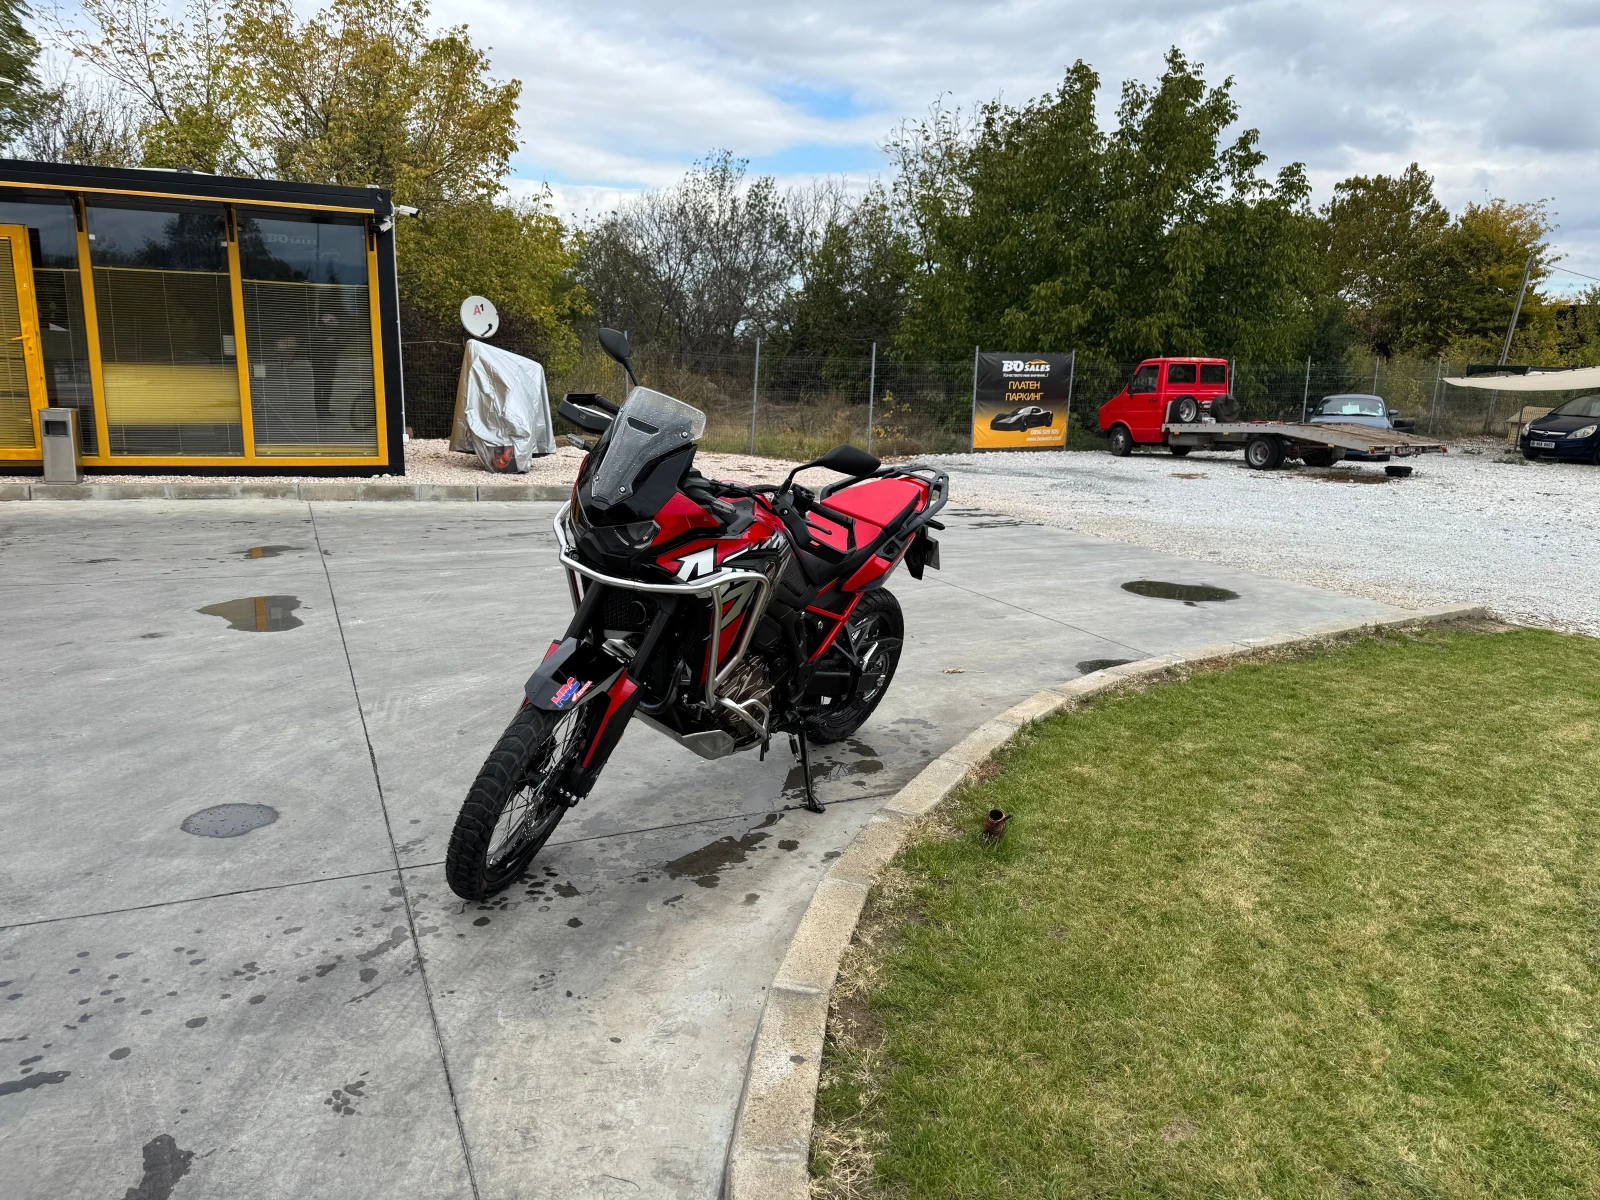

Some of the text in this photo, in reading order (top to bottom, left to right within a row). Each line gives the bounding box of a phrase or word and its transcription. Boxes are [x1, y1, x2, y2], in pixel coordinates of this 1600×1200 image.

[473, 303, 484, 315] A1
[1024, 364, 1051, 372] SALES
[1008, 380, 1041, 390] ПЛАТЕН
[1005, 392, 1044, 401] ПАРКИНГ
